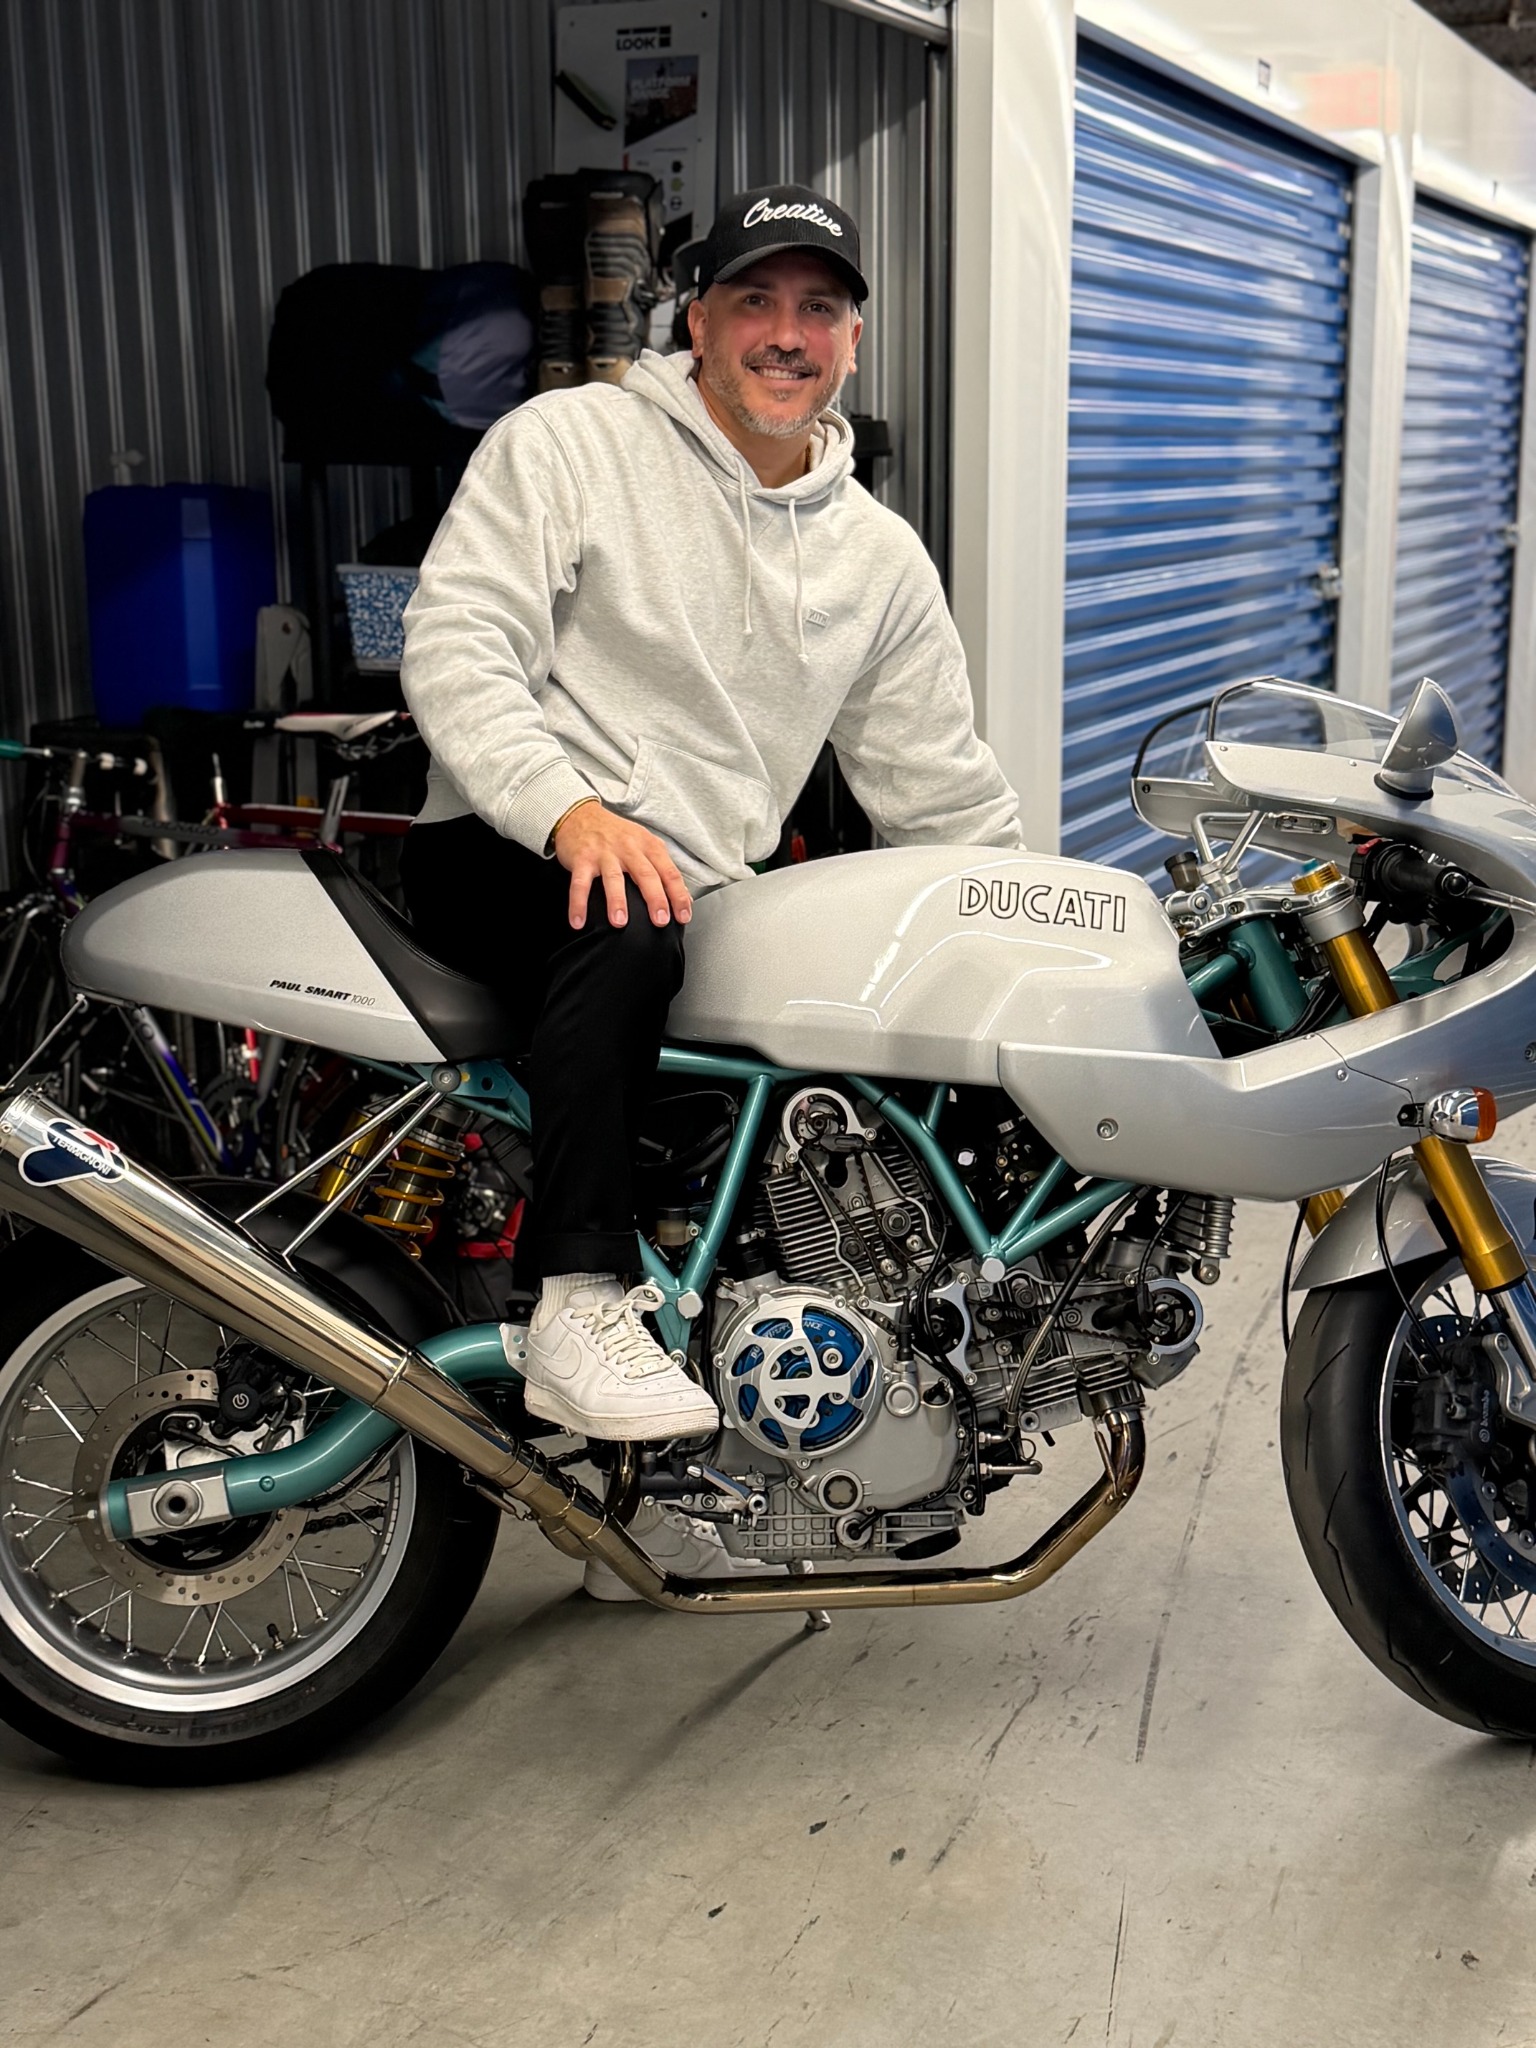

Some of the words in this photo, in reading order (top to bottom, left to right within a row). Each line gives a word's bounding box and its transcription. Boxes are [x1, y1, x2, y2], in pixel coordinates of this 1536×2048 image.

[616, 37, 656, 51] LOOK
[743, 198, 843, 236] Creative
[959, 878, 1126, 933] DUCATI
[270, 980, 301, 992] PAUL
[304, 986, 351, 1001] SMART
[351, 994, 376, 1006] 1000
[52, 1136, 112, 1176] TERMIGNONI
